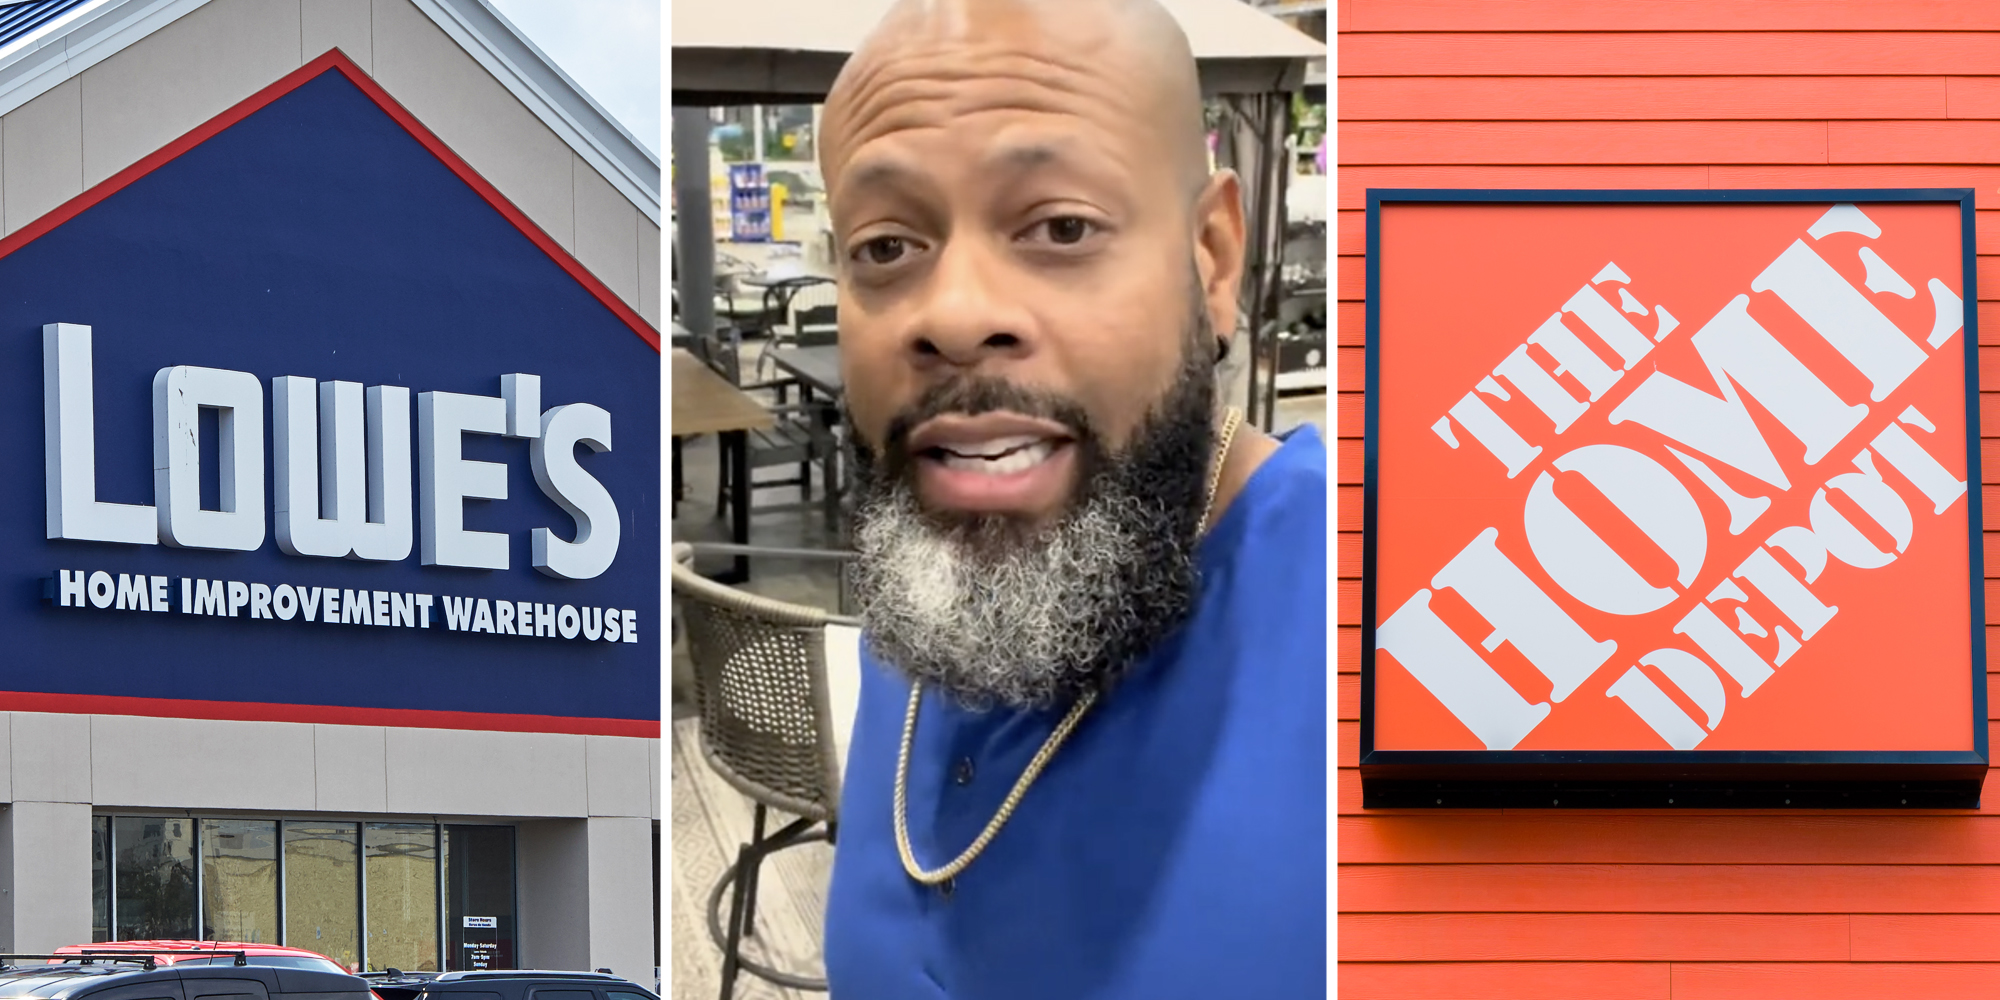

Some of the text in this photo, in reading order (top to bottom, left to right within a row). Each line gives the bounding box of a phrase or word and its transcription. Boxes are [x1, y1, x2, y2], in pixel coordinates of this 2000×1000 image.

[43, 322, 621, 580] LOWE'S
[1376, 203, 1964, 750] HOME
[1431, 261, 1680, 479] THE
[59, 569, 639, 644] HOME IMPROVEMENT WAREHOUSE
[1605, 404, 1967, 750] DEPOT
